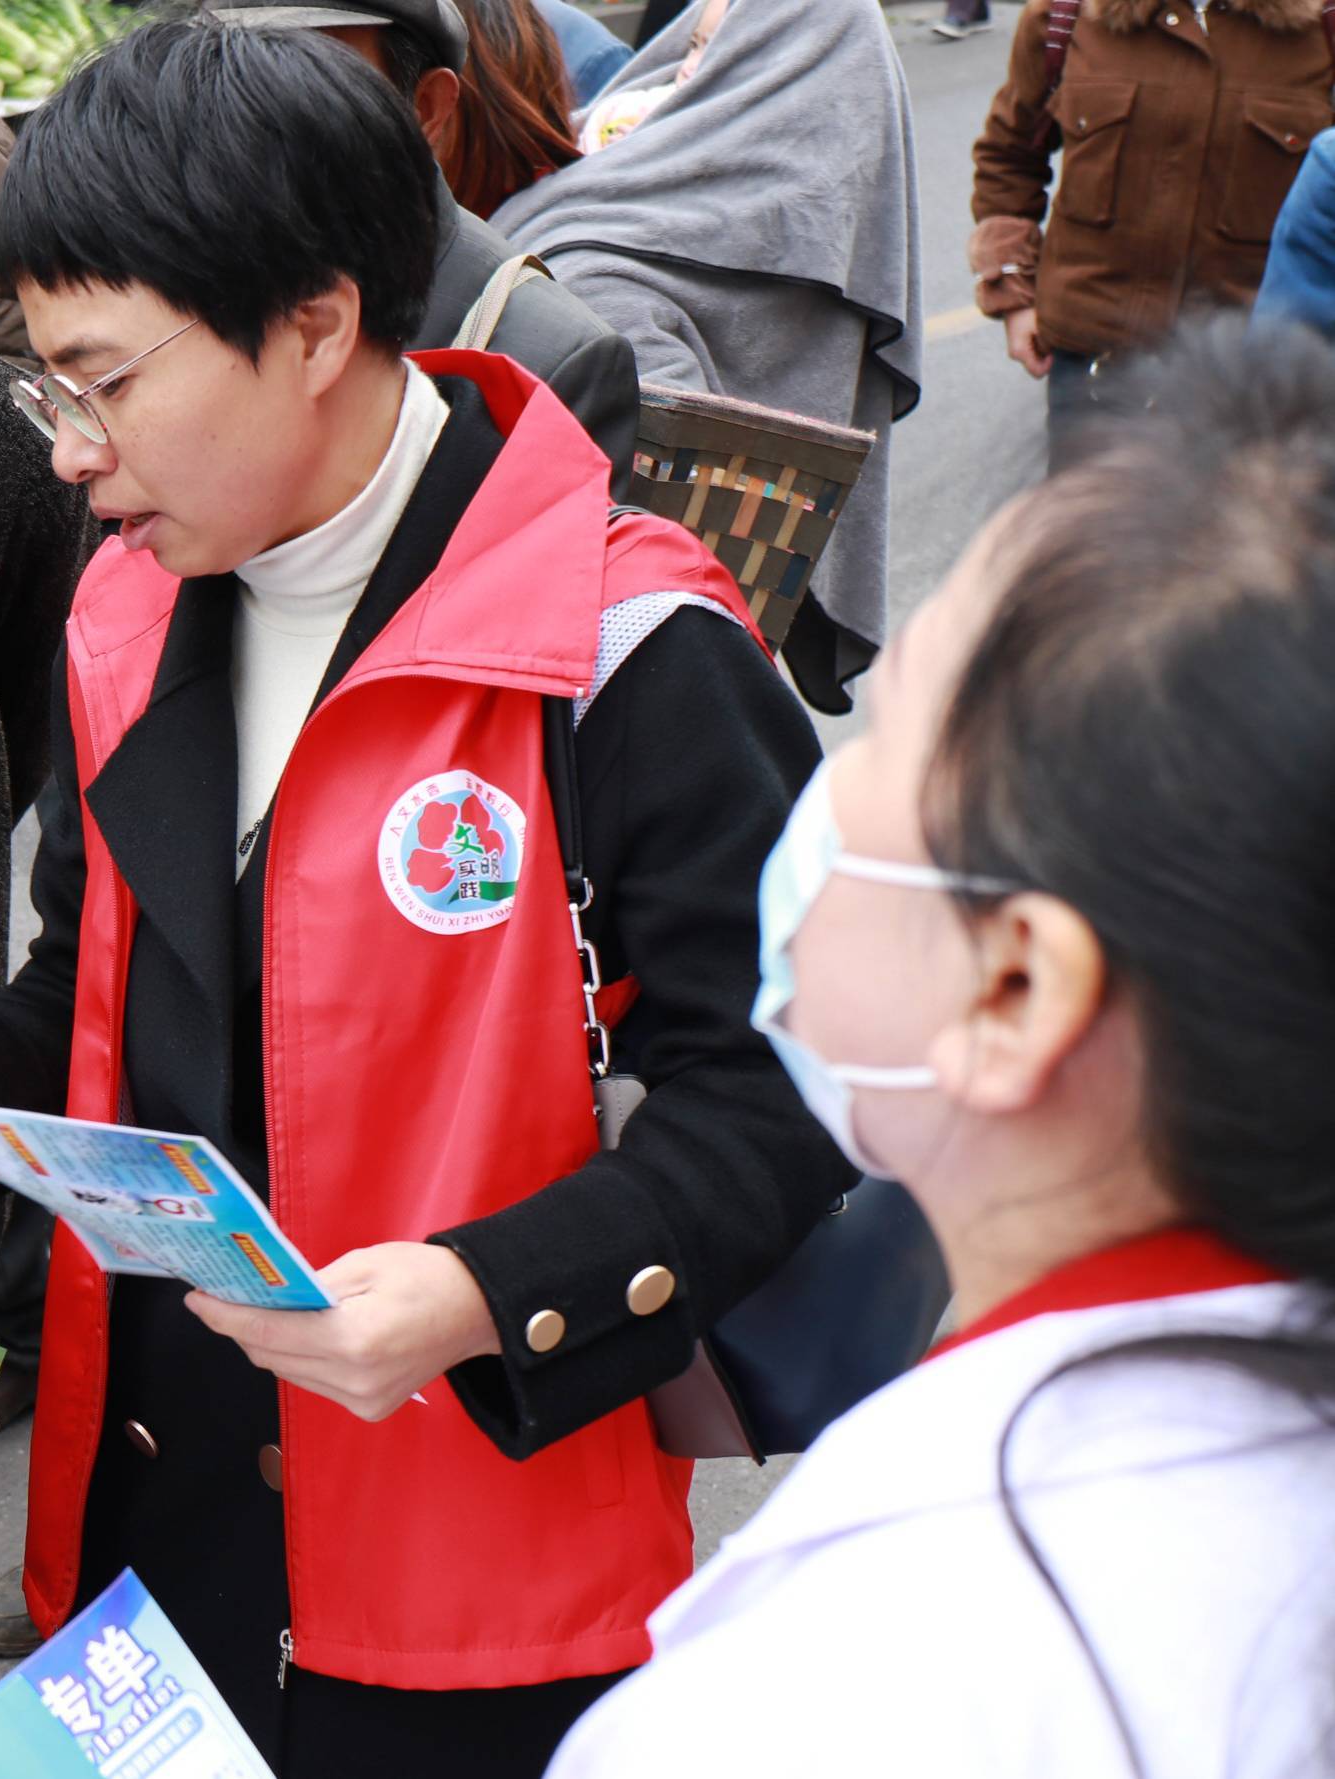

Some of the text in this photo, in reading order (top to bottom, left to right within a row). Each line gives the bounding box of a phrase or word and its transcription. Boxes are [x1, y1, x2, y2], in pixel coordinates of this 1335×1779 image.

[385, 856, 515, 927] REN WEN SHUI XI ZHI YUA
[97, 1673, 184, 1760] leaflet
